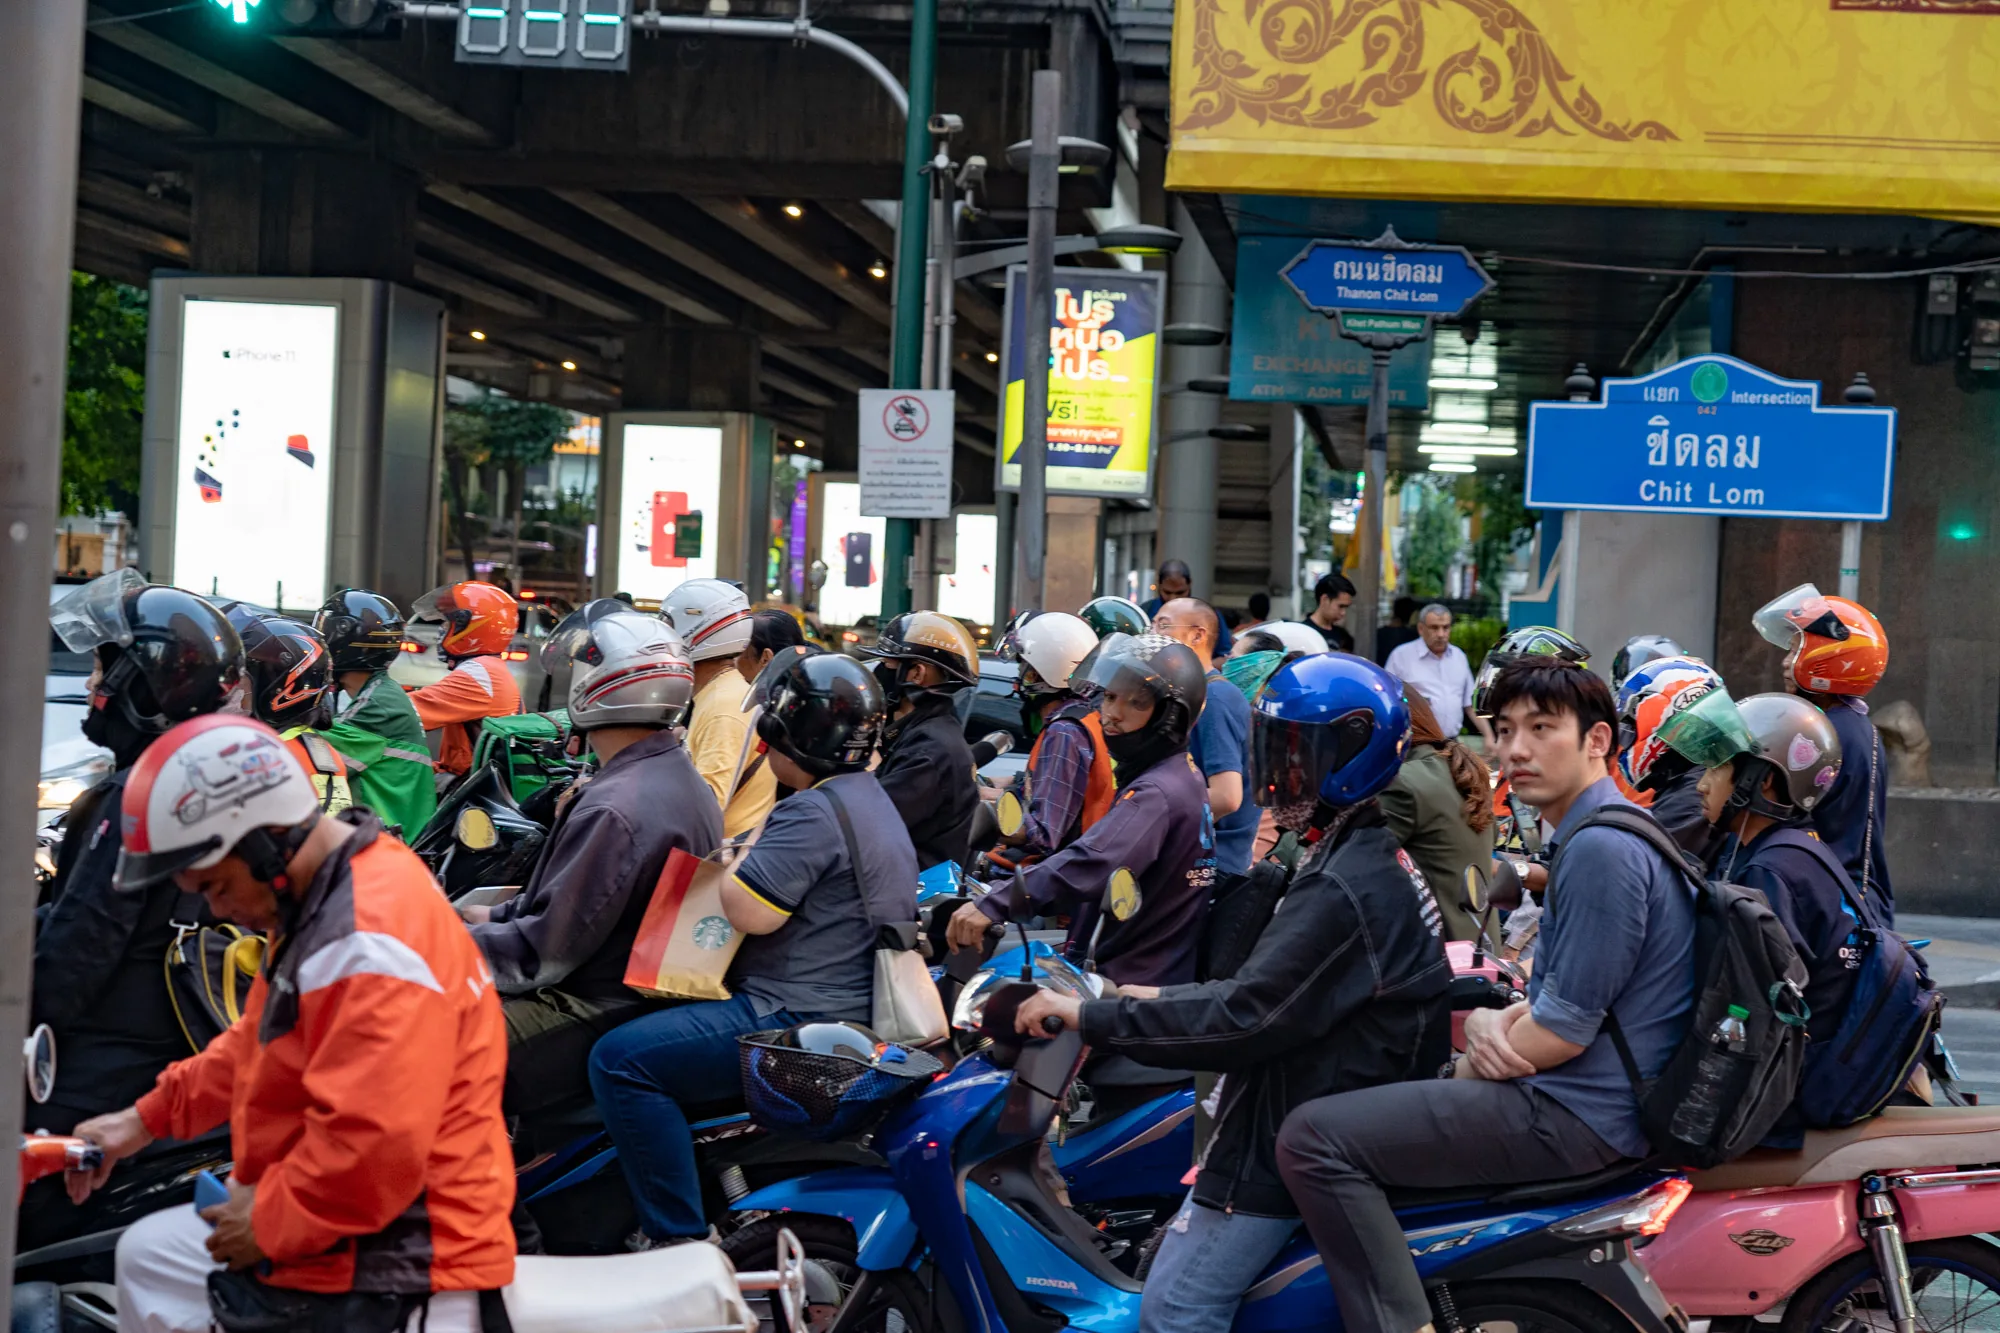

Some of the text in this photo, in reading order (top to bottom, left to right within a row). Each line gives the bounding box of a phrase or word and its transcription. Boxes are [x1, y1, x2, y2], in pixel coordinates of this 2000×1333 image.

[1333, 253, 1443, 284] ถนนชิดลม
[1336, 286, 1438, 302] Thanon Chit Lom
[1252, 355, 1369, 375] EXCHANGE
[1251, 384, 1407, 401] ATM ADM UPTE
[1643, 385, 1680, 403] แยก
[1731, 390, 1811, 406] Intersection
[1697, 405, 1717, 414] 042
[1646, 415, 1760, 469] ชิดลม
[1639, 480, 1765, 506] Chit Lom
[1026, 1276, 1078, 1290] HONDA
